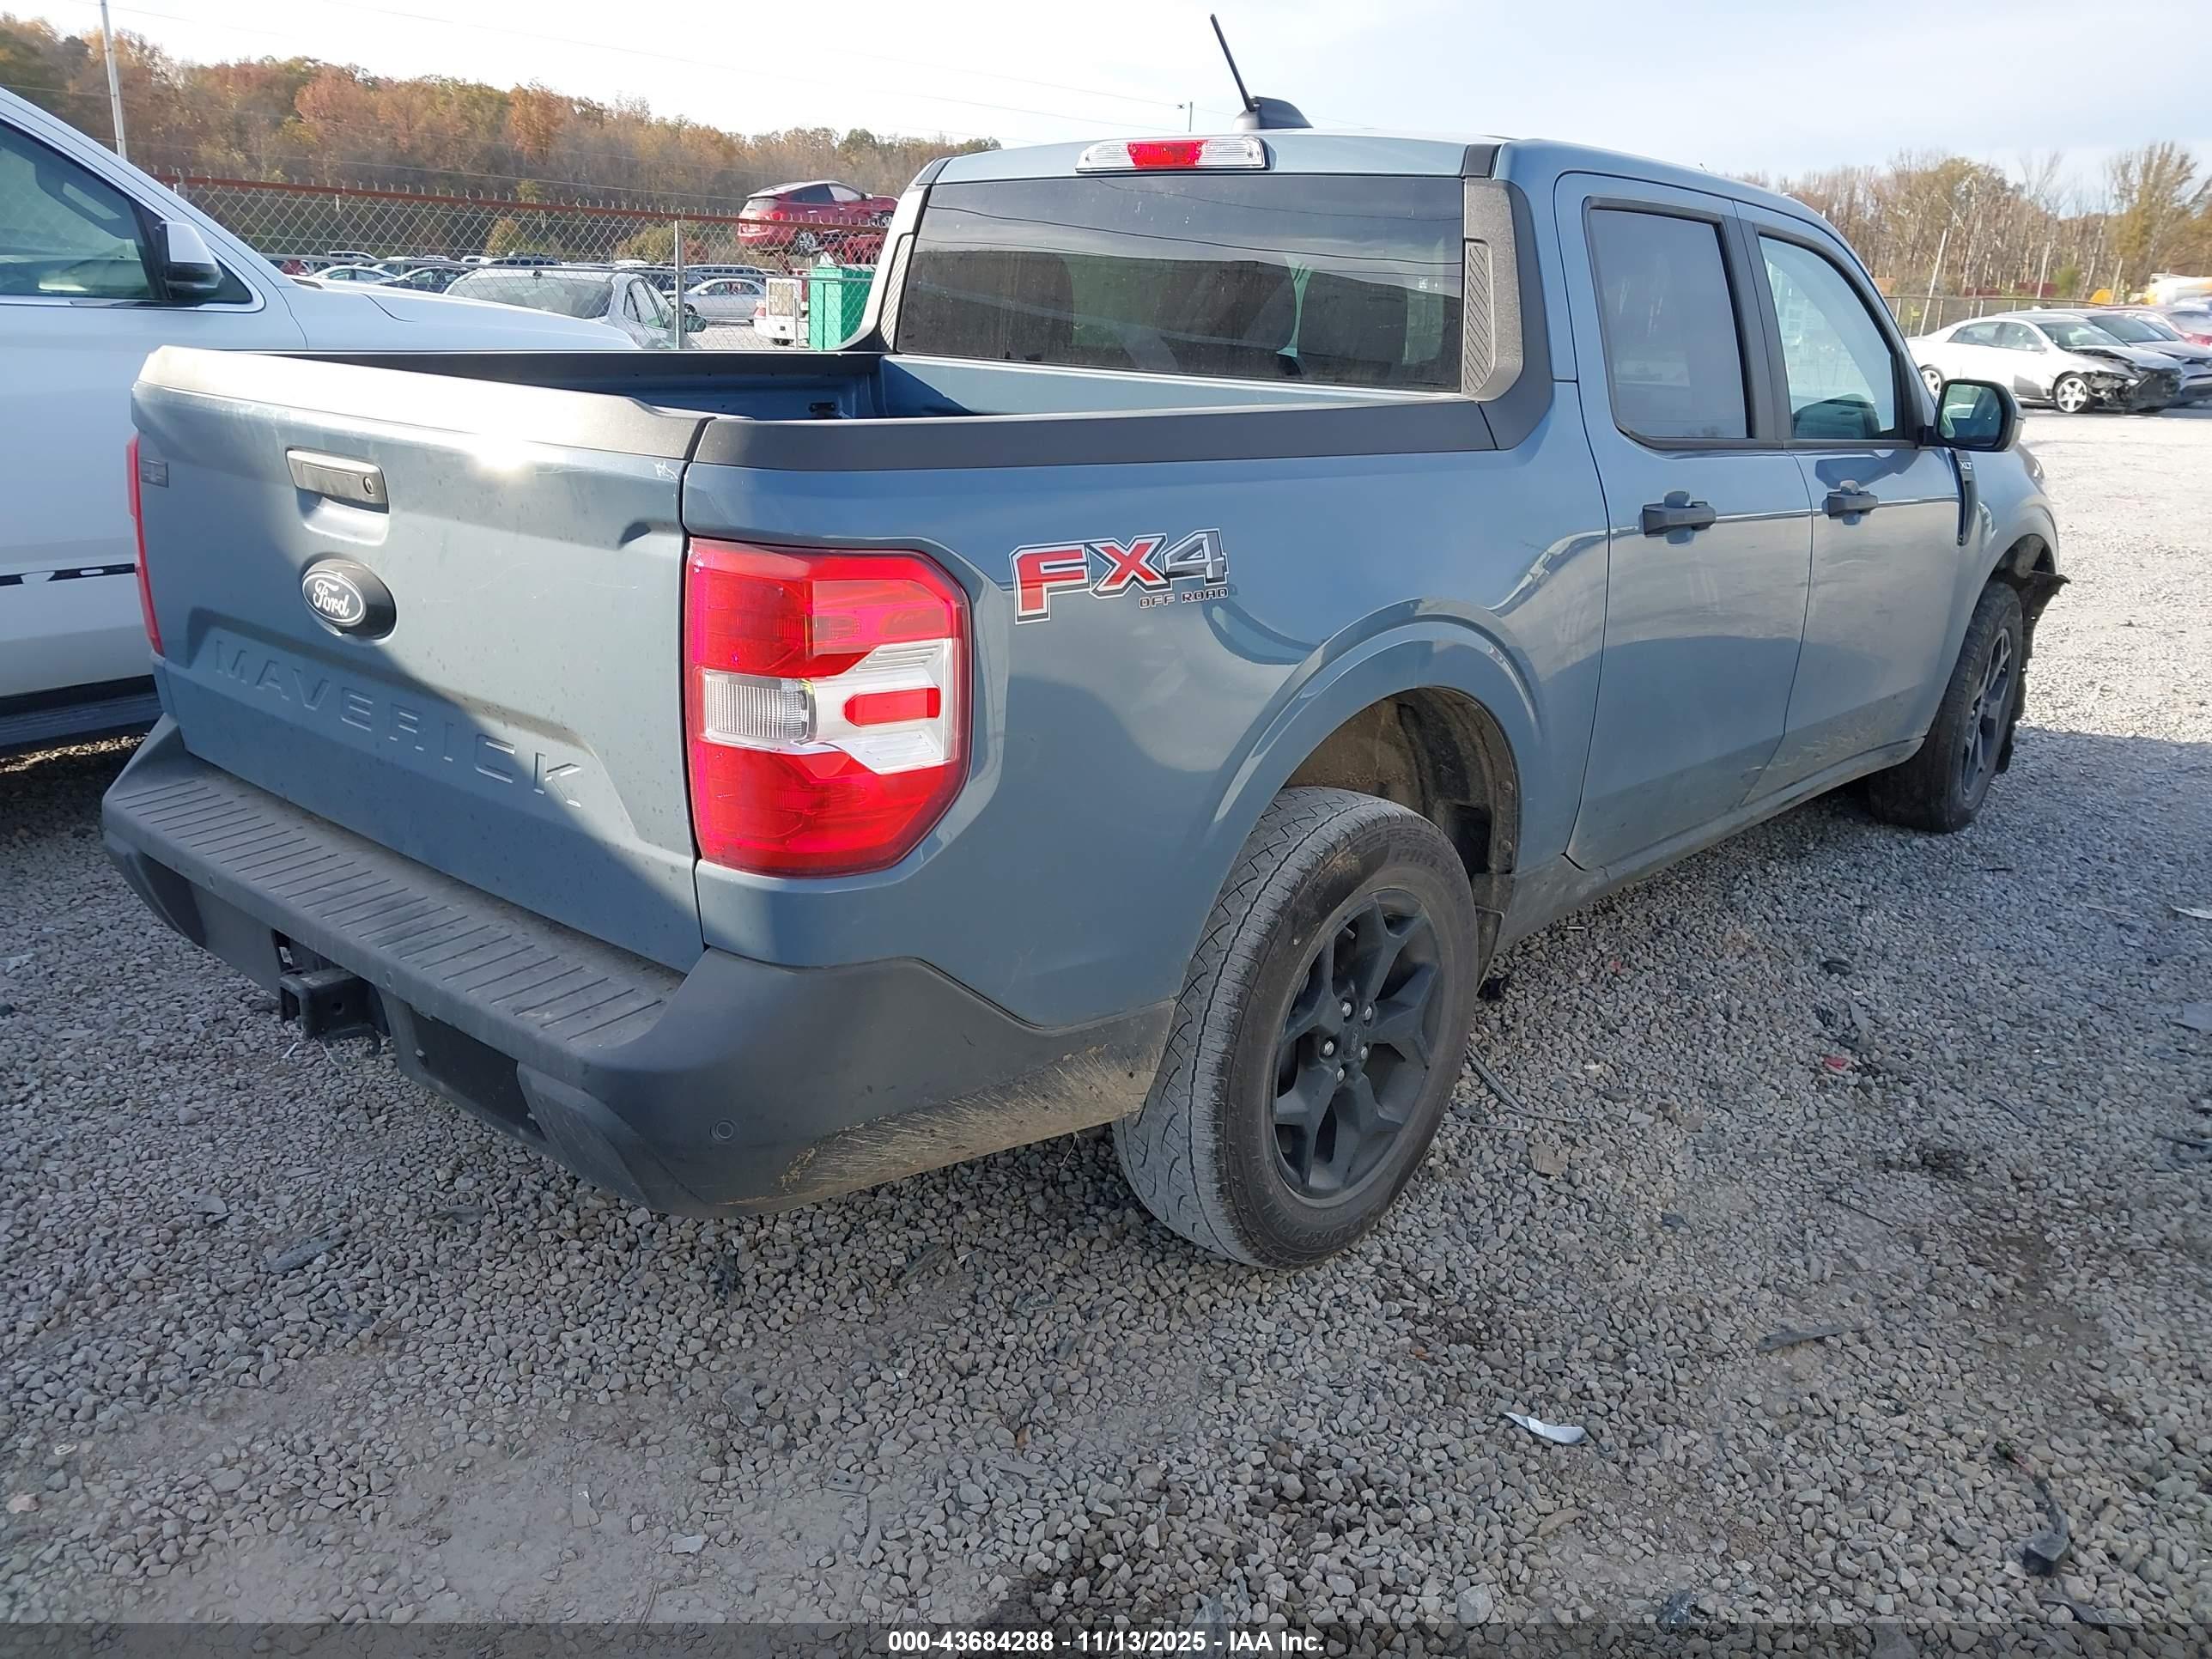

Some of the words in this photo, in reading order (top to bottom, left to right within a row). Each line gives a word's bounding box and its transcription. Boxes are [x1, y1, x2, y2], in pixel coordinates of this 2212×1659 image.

[313, 579, 349, 617] Ford
[1008, 528, 1230, 625] FX4
[1139, 593, 1176, 609] OFF
[1181, 586, 1229, 604] ROAD
[215, 640, 582, 808] MAVERICK
